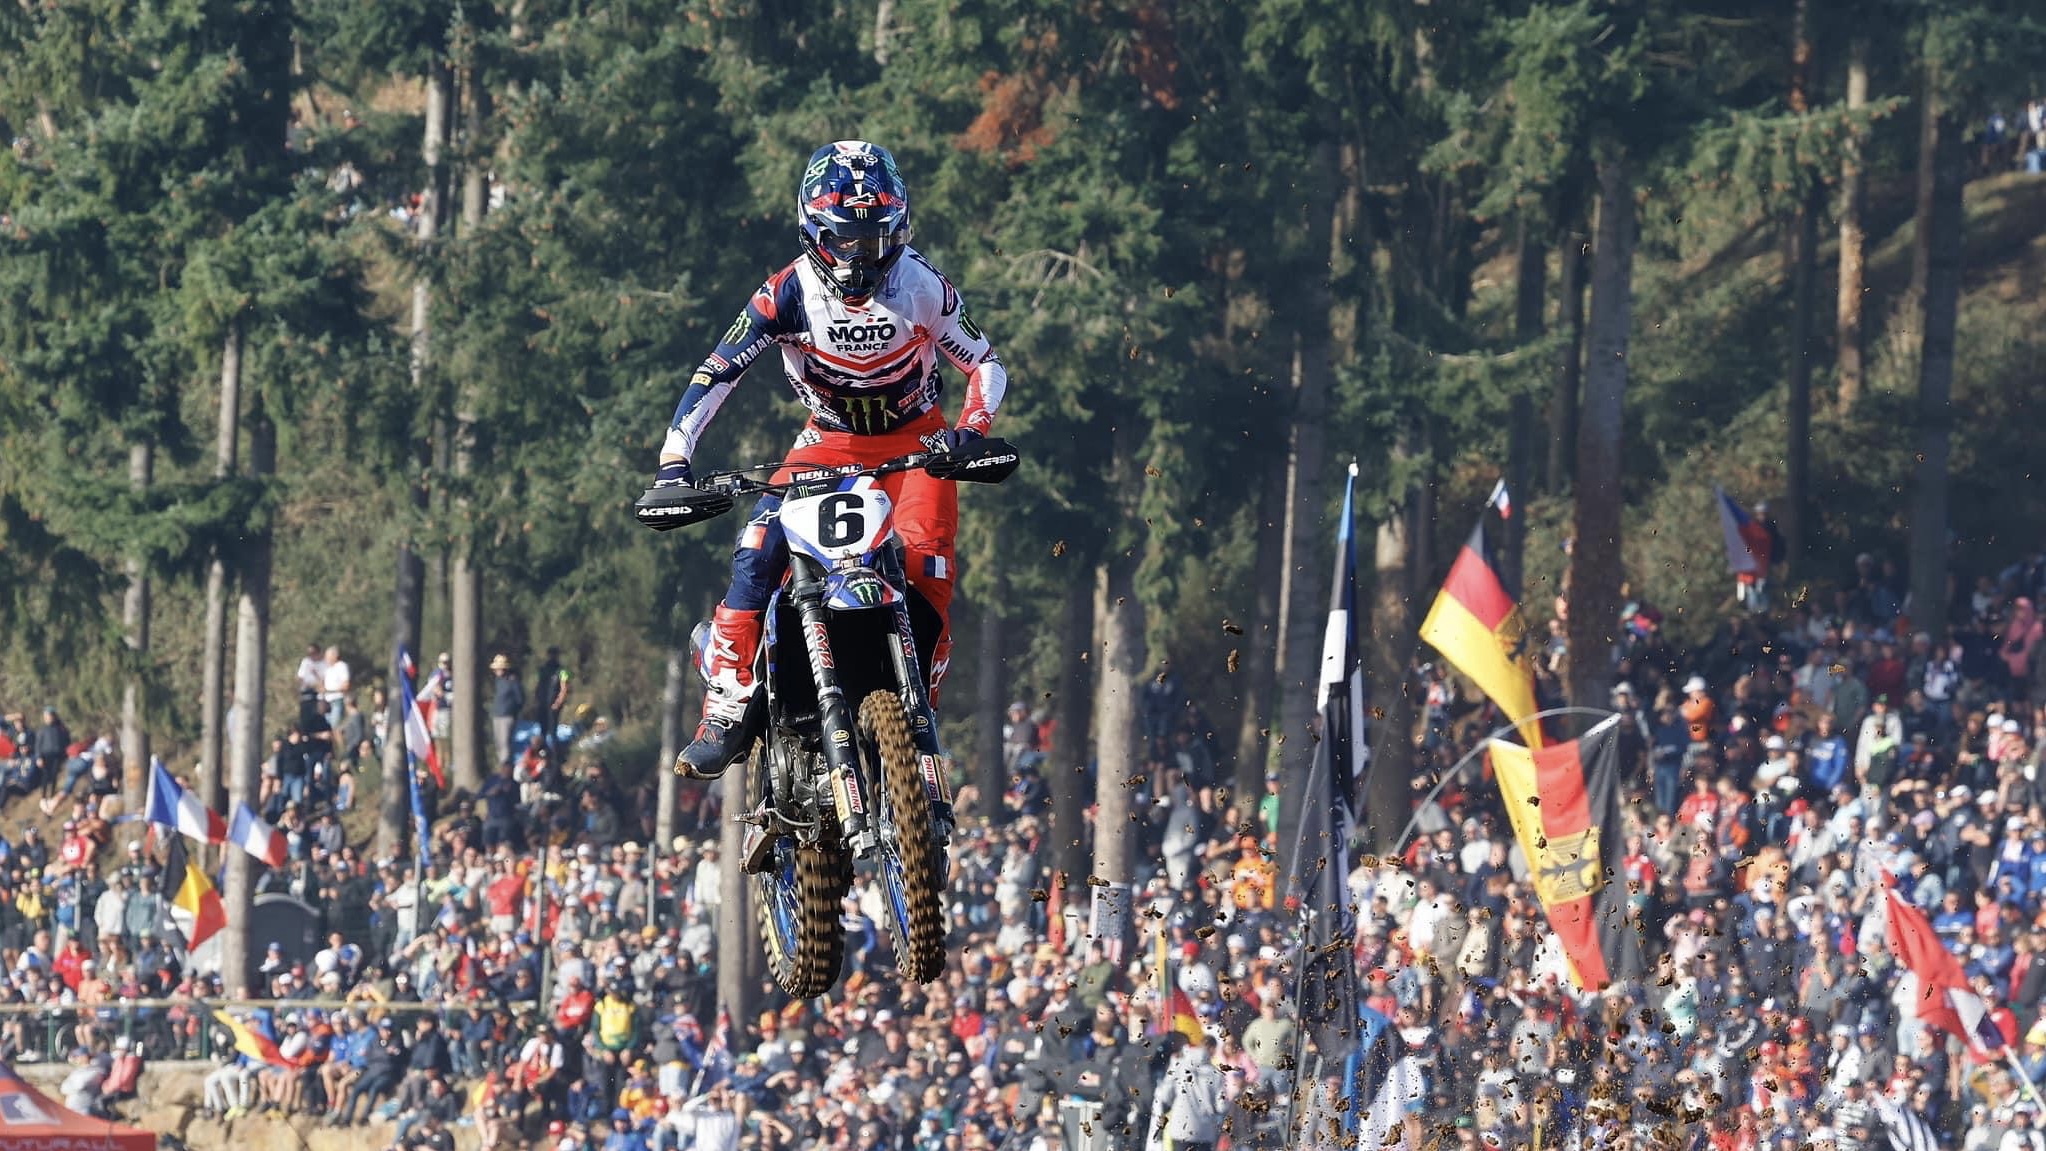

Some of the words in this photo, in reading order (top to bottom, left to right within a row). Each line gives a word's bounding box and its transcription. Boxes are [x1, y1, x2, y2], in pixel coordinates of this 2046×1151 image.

[827, 319, 897, 343] MOTO
[731, 332, 776, 368] YAMAHA
[836, 342, 890, 352] FRANCE
[938, 332, 975, 366] YAMAHA
[795, 465, 859, 481] RENTAL
[966, 453, 1017, 470] ACERBIS
[638, 505, 693, 517] ACERBIS
[817, 493, 865, 548] 6
[813, 622, 835, 669] KYB
[923, 757, 940, 801] BRAKING
